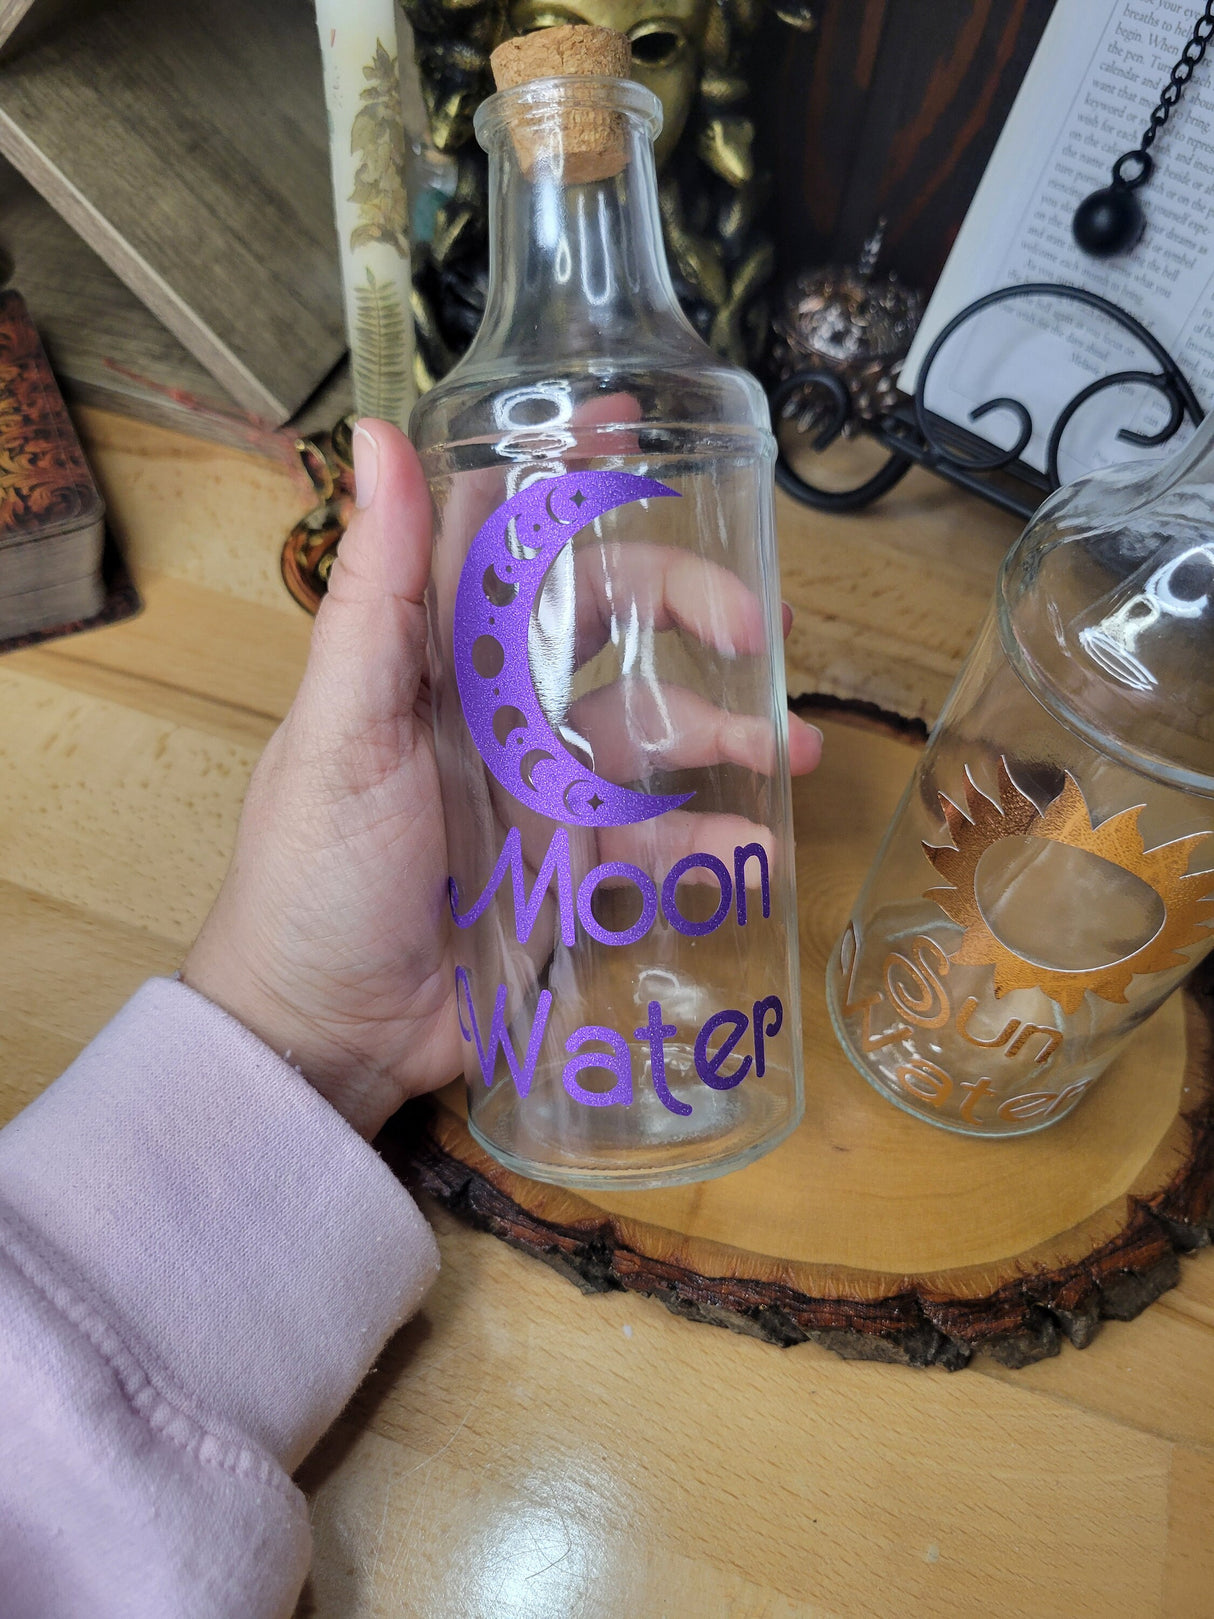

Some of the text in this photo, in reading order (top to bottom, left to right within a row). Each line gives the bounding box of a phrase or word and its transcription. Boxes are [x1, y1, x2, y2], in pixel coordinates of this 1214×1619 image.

[1123, 2, 1160, 27] breaths
[1161, 20, 1173, 32] to
[1156, 0, 1202, 25] your eye
[1107, 40, 1124, 57] the
[1123, 50, 1145, 65] pen.
[1191, 69, 1213, 88] each
[1149, 32, 1179, 56] When
[1099, 60, 1140, 83] calendar
[1141, 77, 1162, 90] and
[1084, 91, 1127, 118] keyword
[1126, 113, 1138, 123] or
[1174, 130, 1186, 141] to
[1092, 79, 1117, 95] want
[1117, 85, 1138, 103] that
[1172, 110, 1184, 121] to
[1077, 113, 1099, 129] wish
[1100, 119, 1116, 134] for
[1116, 129, 1138, 144] each
[1175, 153, 1195, 166] and
[1084, 133, 1100, 148] the
[1162, 163, 1191, 186] beside
[1192, 181, 1204, 191] or
[1062, 144, 1078, 158] the
[1079, 154, 1105, 169] name
[1166, 190, 1177, 200] or
[1177, 196, 1190, 206] on
[1191, 197, 1207, 213] the
[1162, 249, 1197, 270] symbol
[1165, 227, 1197, 250] dreams
[449, 826, 770, 946] Moon
[882, 934, 1064, 1064] Sun
[455, 965, 783, 1116] Water
